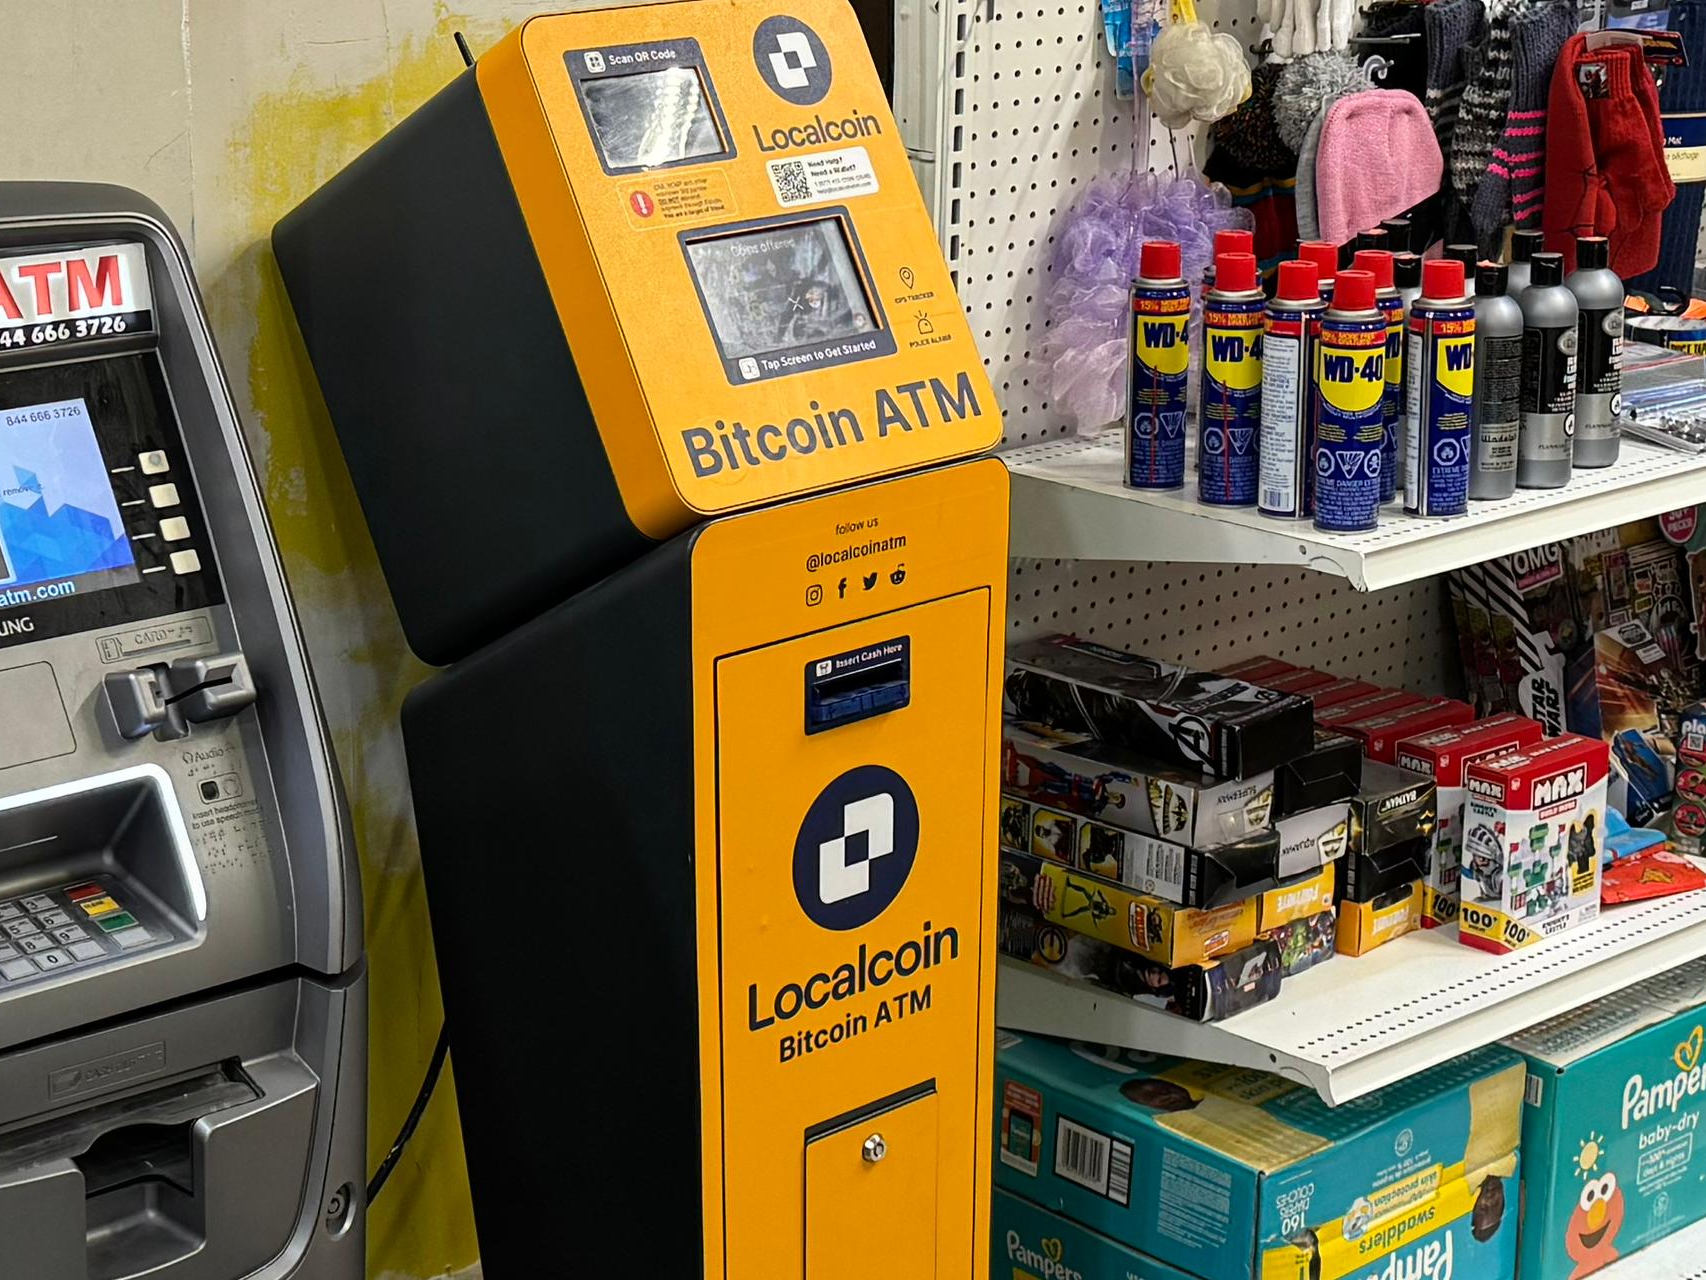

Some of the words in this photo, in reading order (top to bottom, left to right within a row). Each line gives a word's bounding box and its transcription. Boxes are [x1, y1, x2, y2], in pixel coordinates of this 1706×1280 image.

[609, 53, 634, 65] Scan
[635, 51, 649, 62] QR
[651, 49, 676, 60] Code
[752, 110, 881, 153] Localcoin
[31, 322, 72, 343] 666
[76, 315, 127, 338] 3726
[762, 357, 780, 370] Tap
[781, 351, 813, 367] Screen
[814, 350, 824, 360] to
[826, 346, 842, 358] Get
[842, 339, 876, 355] Started
[1324, 354, 1384, 383] WD-40
[54, 406, 81, 420] 3726
[681, 401, 864, 479] Bitcoin
[873, 370, 983, 439] ATM
[835, 519, 862, 536] follow
[864, 516, 880, 529] us
[805, 533, 907, 573] @localcoinatm
[836, 654, 860, 669] Insert
[861, 650, 881, 664] Cash
[883, 642, 904, 659] Here
[1470, 778, 1504, 799] MAX
[1534, 769, 1586, 807] MAX
[46, 954, 59, 964] 0
[748, 921, 959, 1033] Localcoin
[779, 1013, 867, 1064] Bitcoin
[874, 983, 932, 1029] ATM
[1638, 1110, 1700, 1151] baby-dry
[1359, 1205, 1436, 1255] swaddlers
